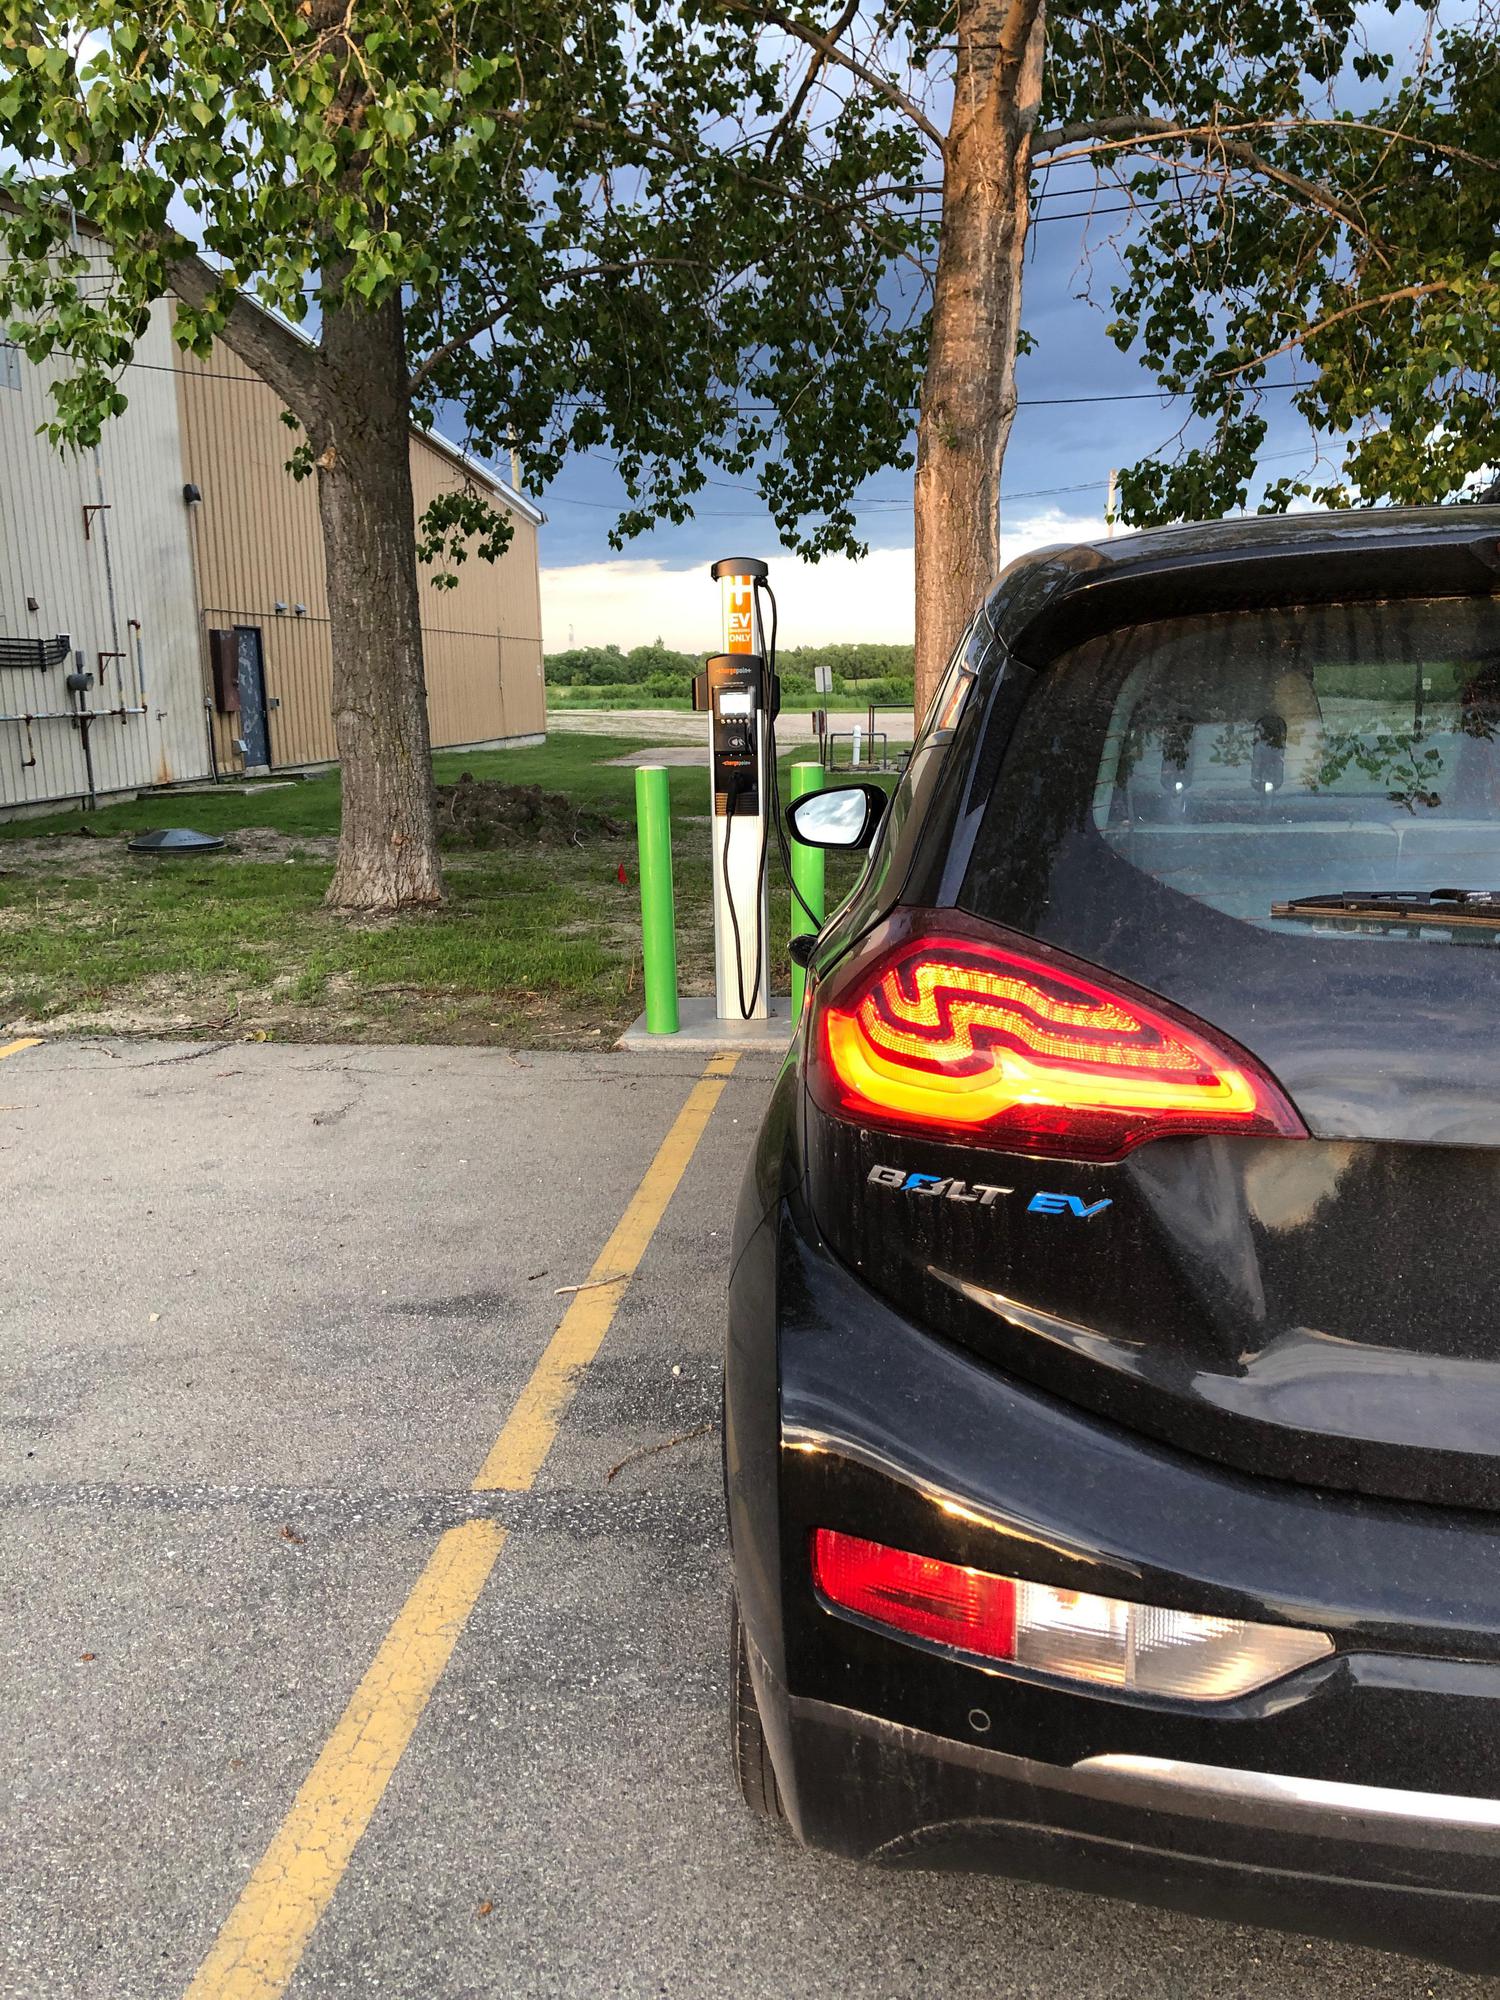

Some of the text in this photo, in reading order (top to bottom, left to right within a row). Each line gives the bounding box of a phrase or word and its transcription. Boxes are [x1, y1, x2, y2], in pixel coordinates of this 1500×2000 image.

[728, 612, 751, 628] EV
[729, 633, 751, 642] ONLY
[866, 1164, 1113, 1218] BOLT EV
